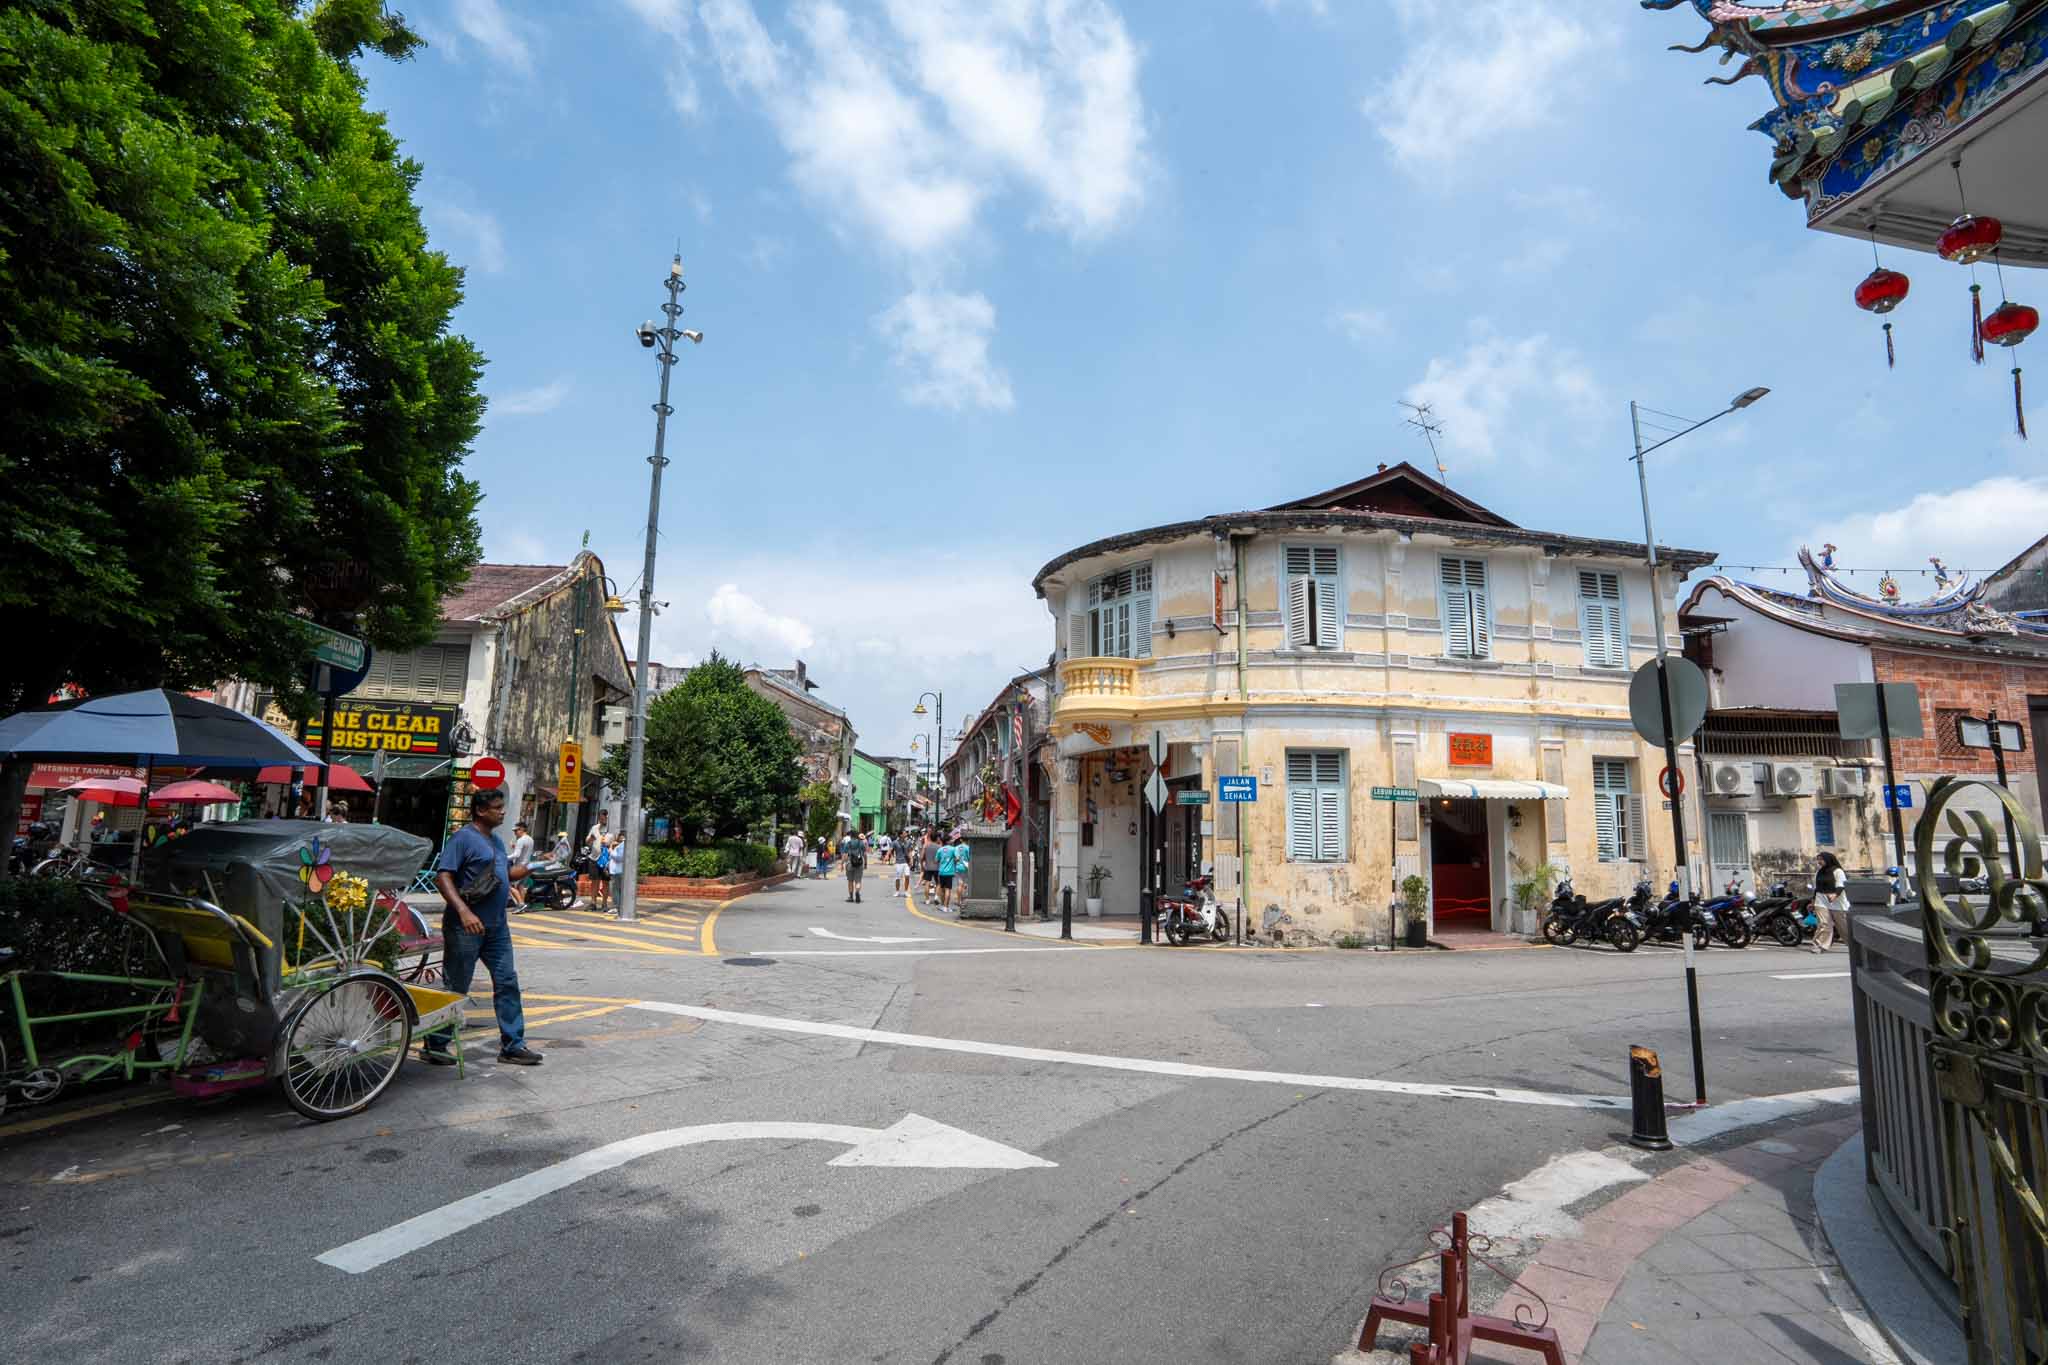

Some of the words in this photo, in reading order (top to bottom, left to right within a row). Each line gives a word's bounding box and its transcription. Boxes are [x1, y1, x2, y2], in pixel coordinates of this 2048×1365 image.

[308, 711, 361, 729] LNE
[367, 713, 440, 733] CLEAR
[331, 730, 412, 750] BISTRO
[37, 763, 80, 773] INTERNET
[1224, 792, 1252, 800] SEHALA
